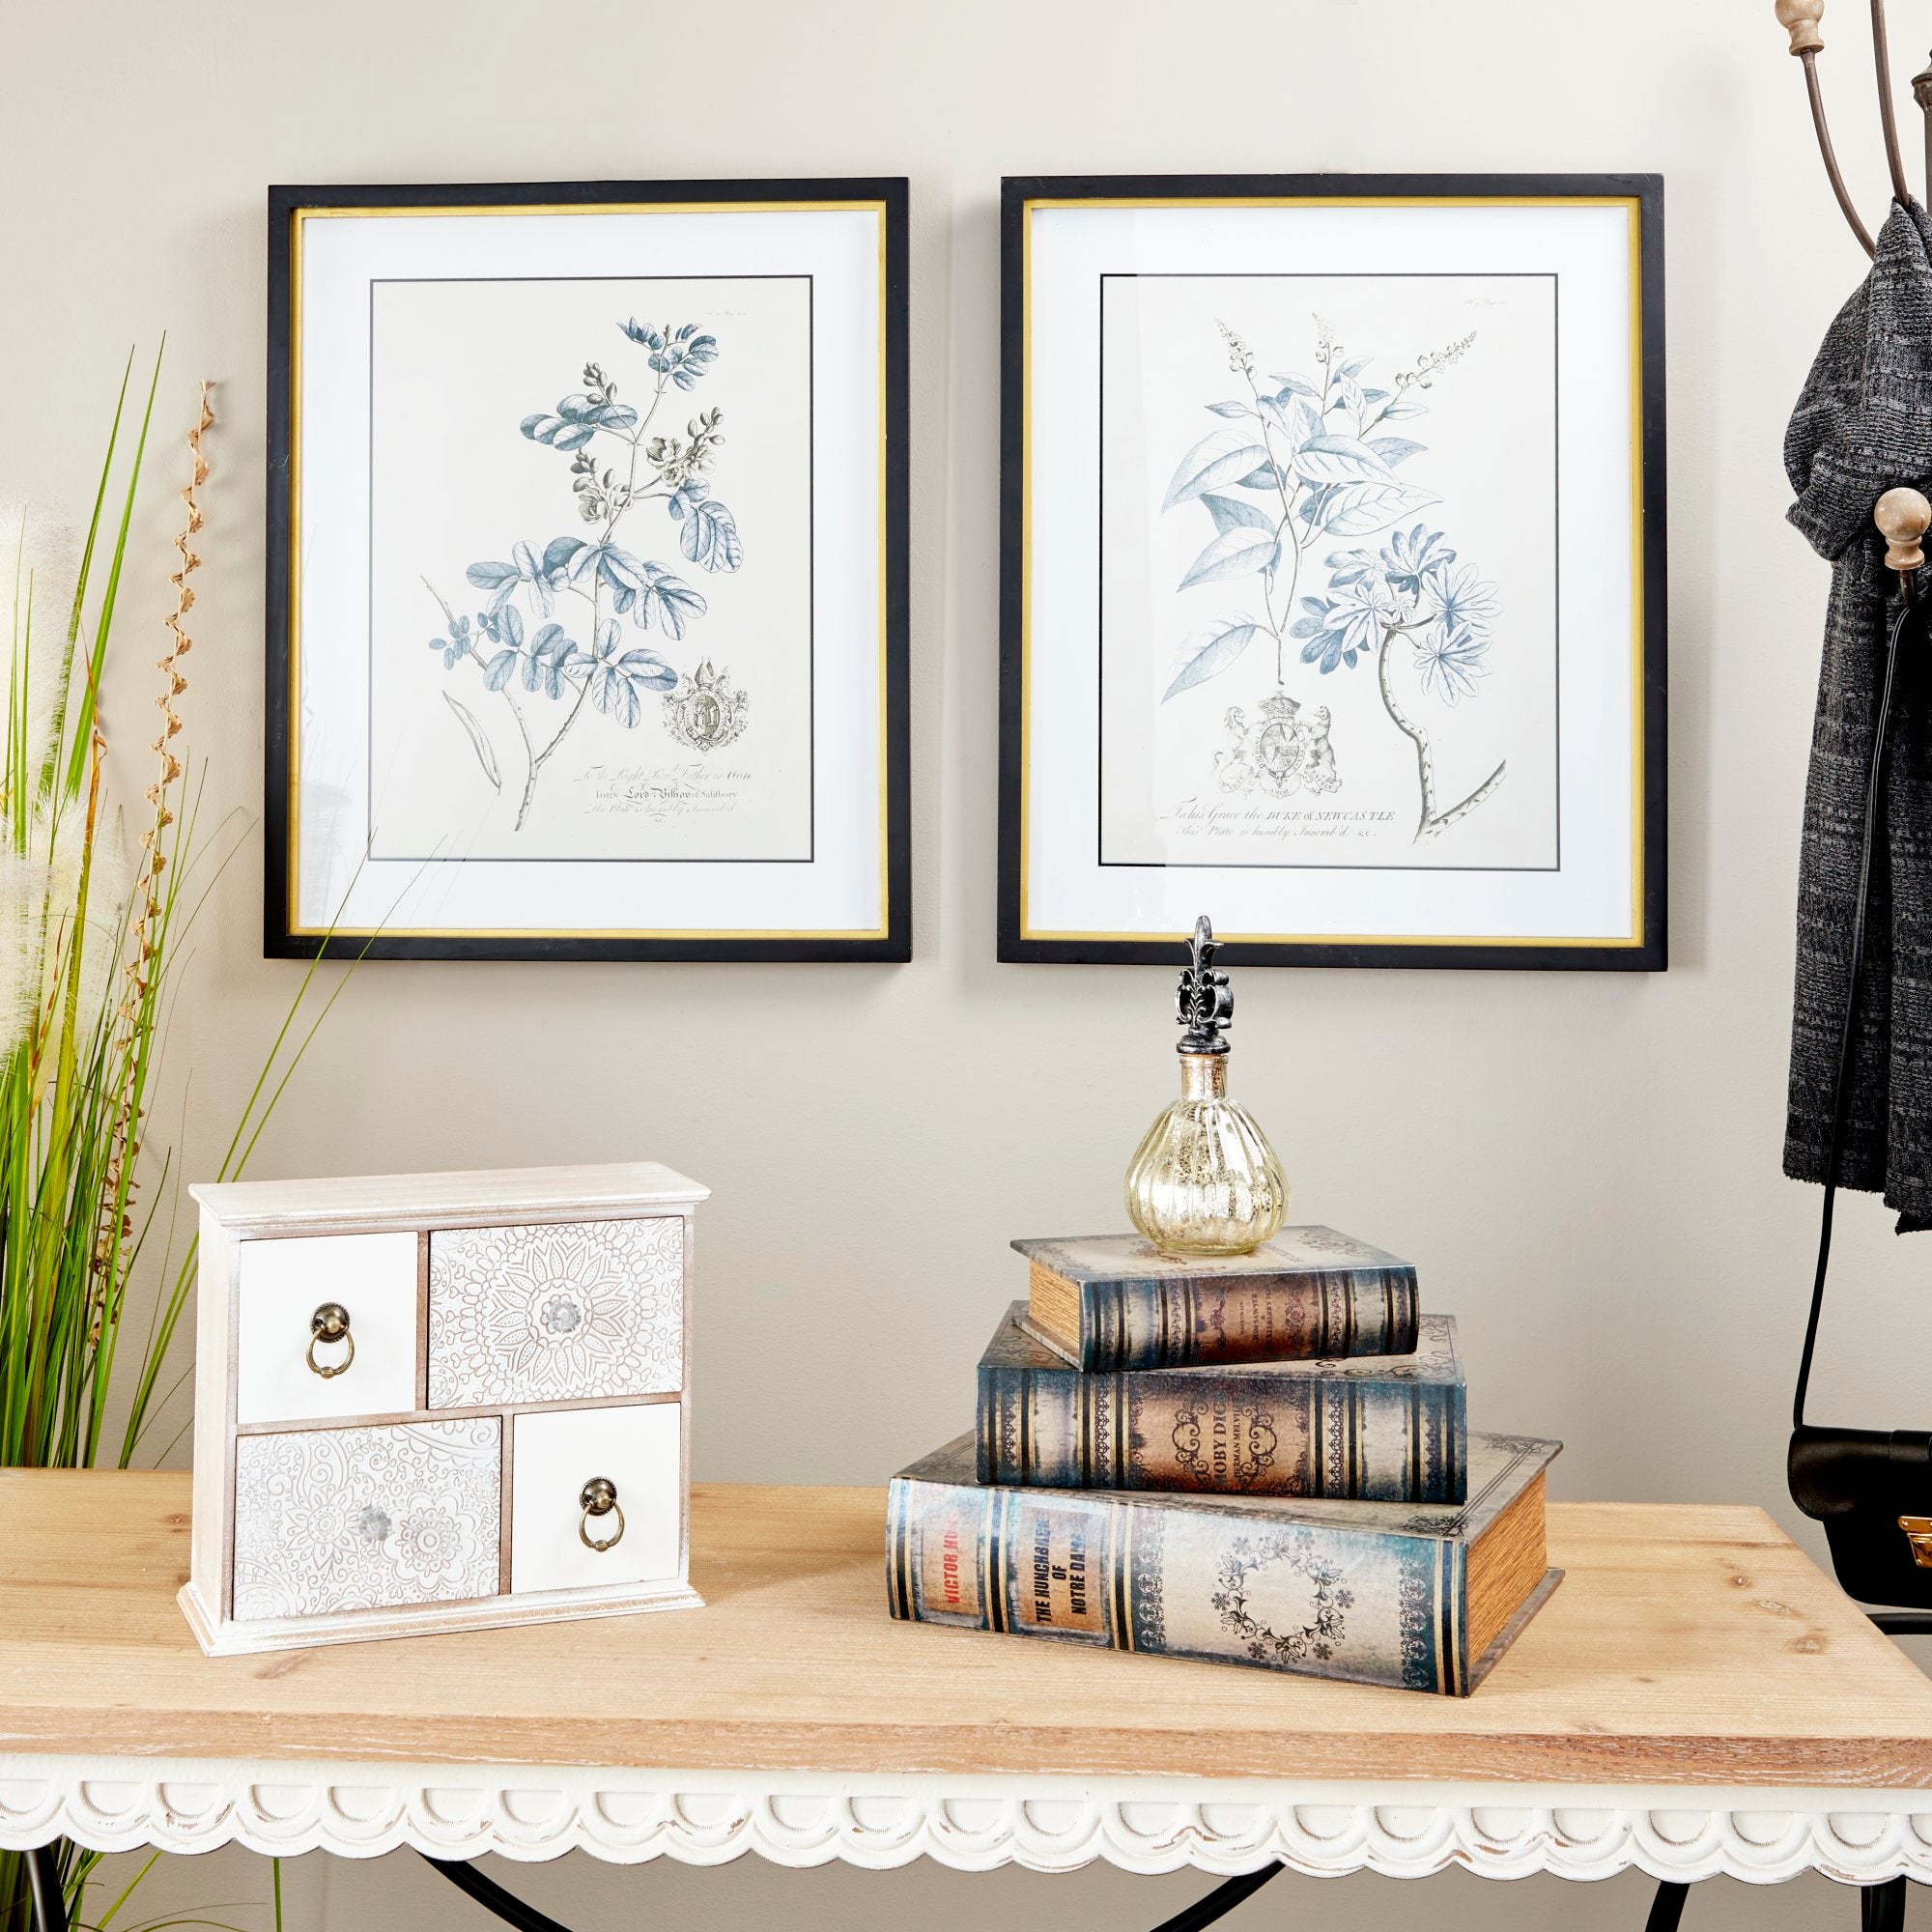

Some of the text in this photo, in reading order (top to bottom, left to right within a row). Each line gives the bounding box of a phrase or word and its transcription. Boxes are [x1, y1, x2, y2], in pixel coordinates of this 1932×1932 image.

[1244, 805, 1263, 819] the
[1264, 811, 1302, 820] DUKE
[1303, 811, 1314, 820] of
[1315, 811, 1396, 820] NEWCASTLE
[1213, 1392, 1226, 1435] DIC
[944, 1511, 959, 1604] VICTOR HU
[1035, 1518, 1051, 1622] THE HUNCHBACK
[1052, 1565, 1066, 1580] OF
[1070, 1575, 1086, 1614] NOTRE
